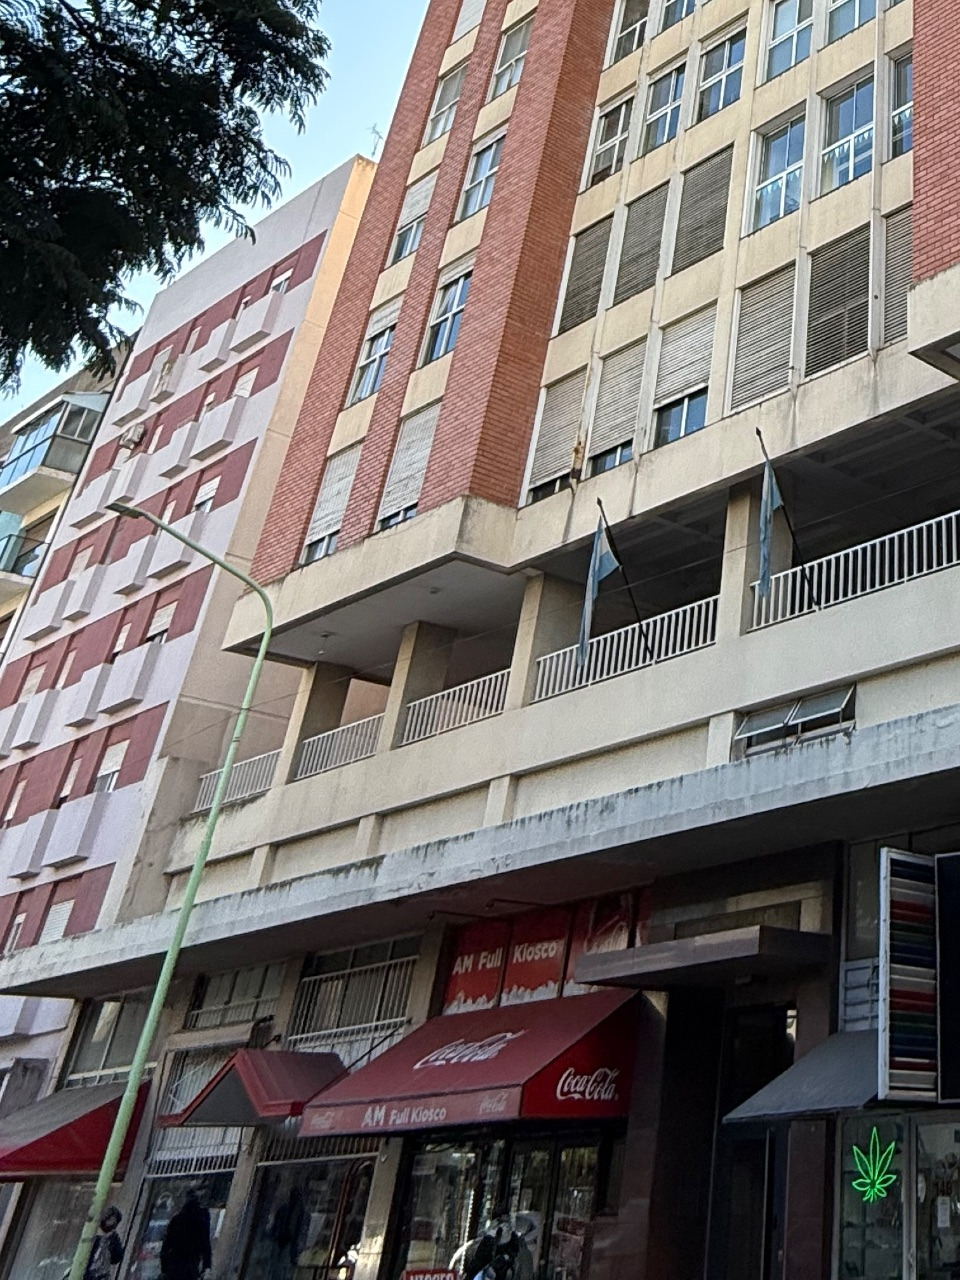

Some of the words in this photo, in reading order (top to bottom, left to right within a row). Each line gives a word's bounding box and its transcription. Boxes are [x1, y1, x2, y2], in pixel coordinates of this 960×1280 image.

[452, 953, 474, 975] AM
[478, 947, 503, 970] Full
[512, 941, 558, 964] Kiosco
[413, 1029, 530, 1071] Coca-Cola
[556, 1066, 621, 1101] Coca-Cola
[361, 1104, 387, 1128] AM
[388, 1108, 410, 1126] Full
[410, 1106, 447, 1123] Kiosco
